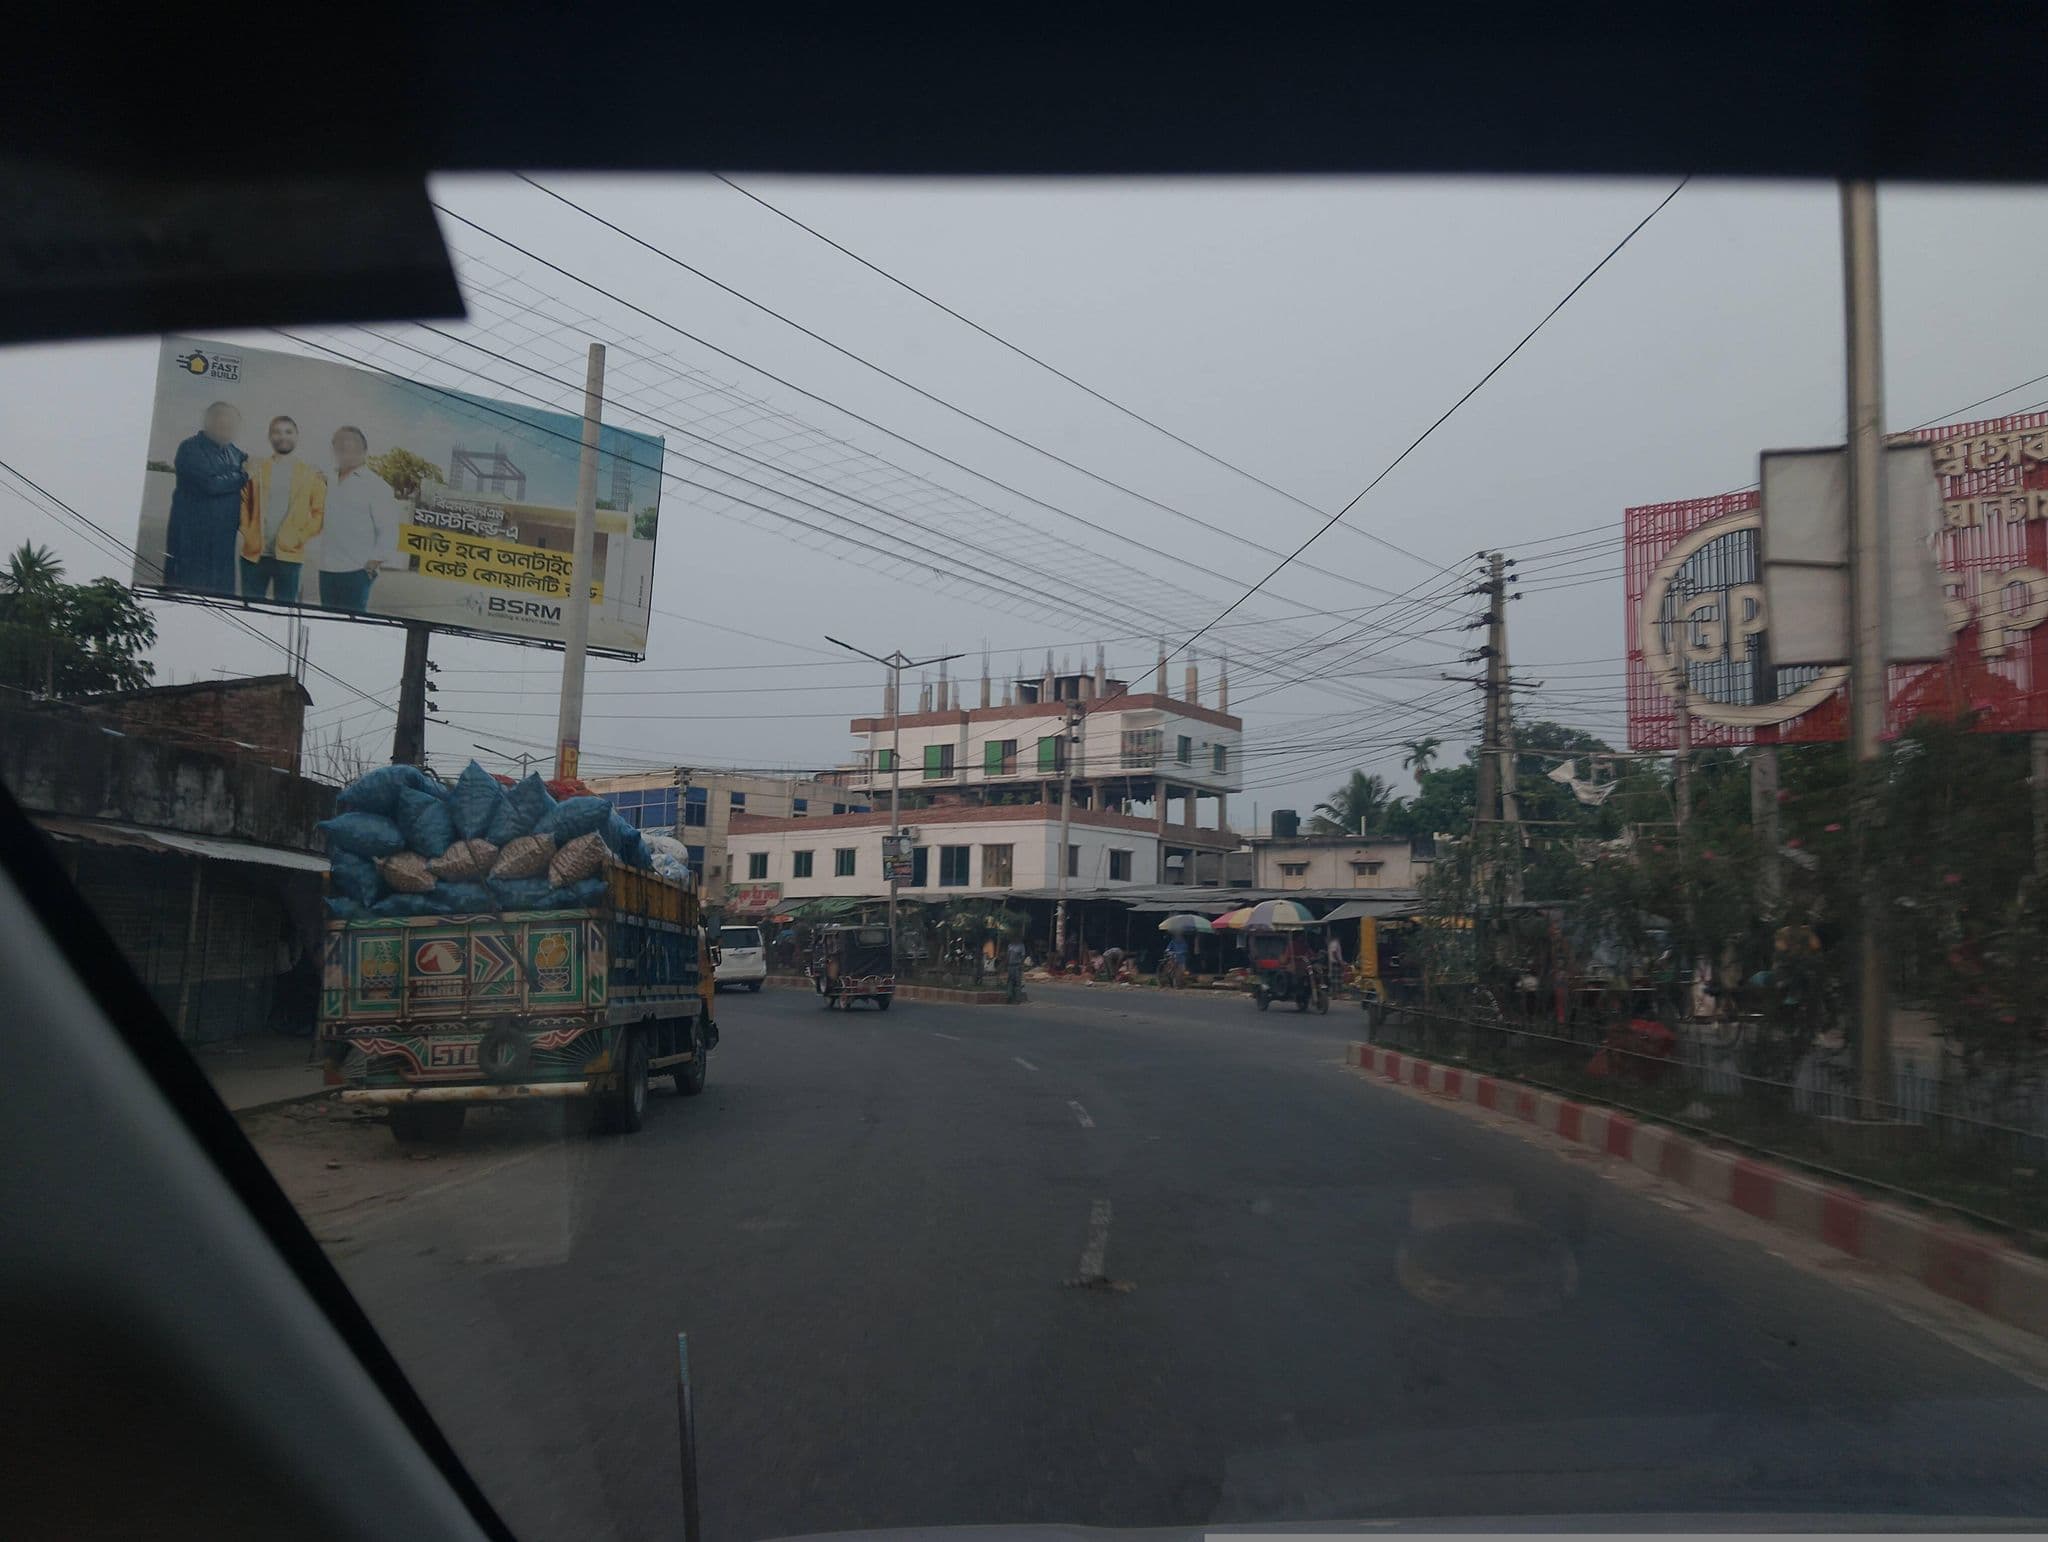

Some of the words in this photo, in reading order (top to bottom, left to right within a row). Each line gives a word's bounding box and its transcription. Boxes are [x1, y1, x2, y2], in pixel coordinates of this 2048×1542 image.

[210, 370, 239, 380] BUILD
[211, 361, 239, 373] FAST
[407, 532, 451, 557] বাড়ি
[455, 541, 493, 562] হবে
[425, 560, 468, 577] বেস্ট
[473, 567, 560, 593] কোয়ালিটি
[488, 597, 561, 620] BSRM
[1682, 583, 1769, 664] GP
[434, 1045, 480, 1065] STO
